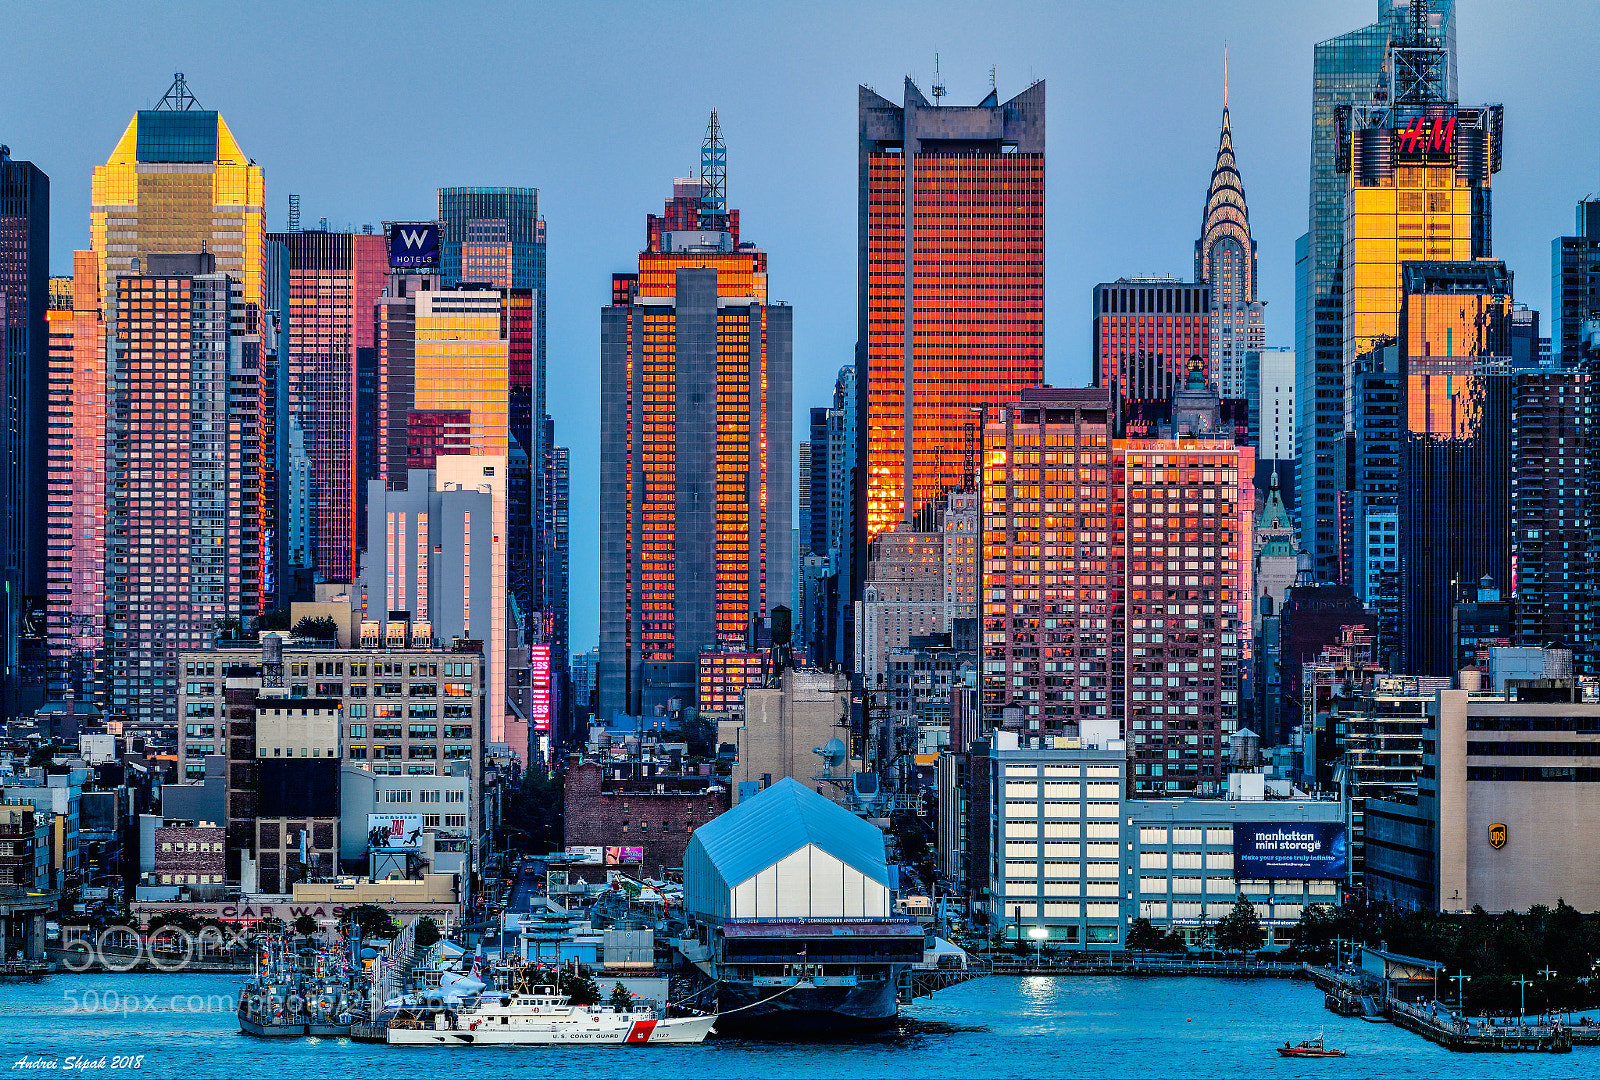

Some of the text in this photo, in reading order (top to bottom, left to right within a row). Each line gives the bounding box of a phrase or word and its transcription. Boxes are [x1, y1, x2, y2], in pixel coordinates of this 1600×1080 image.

[1398, 116, 1456, 153] H&M
[400, 229, 428, 249] W
[1255, 828, 1314, 840] manhattan
[1490, 831, 1504, 845] ups
[1255, 839, 1321, 852] mini storage
[222, 907, 345, 917] CAR WAS
